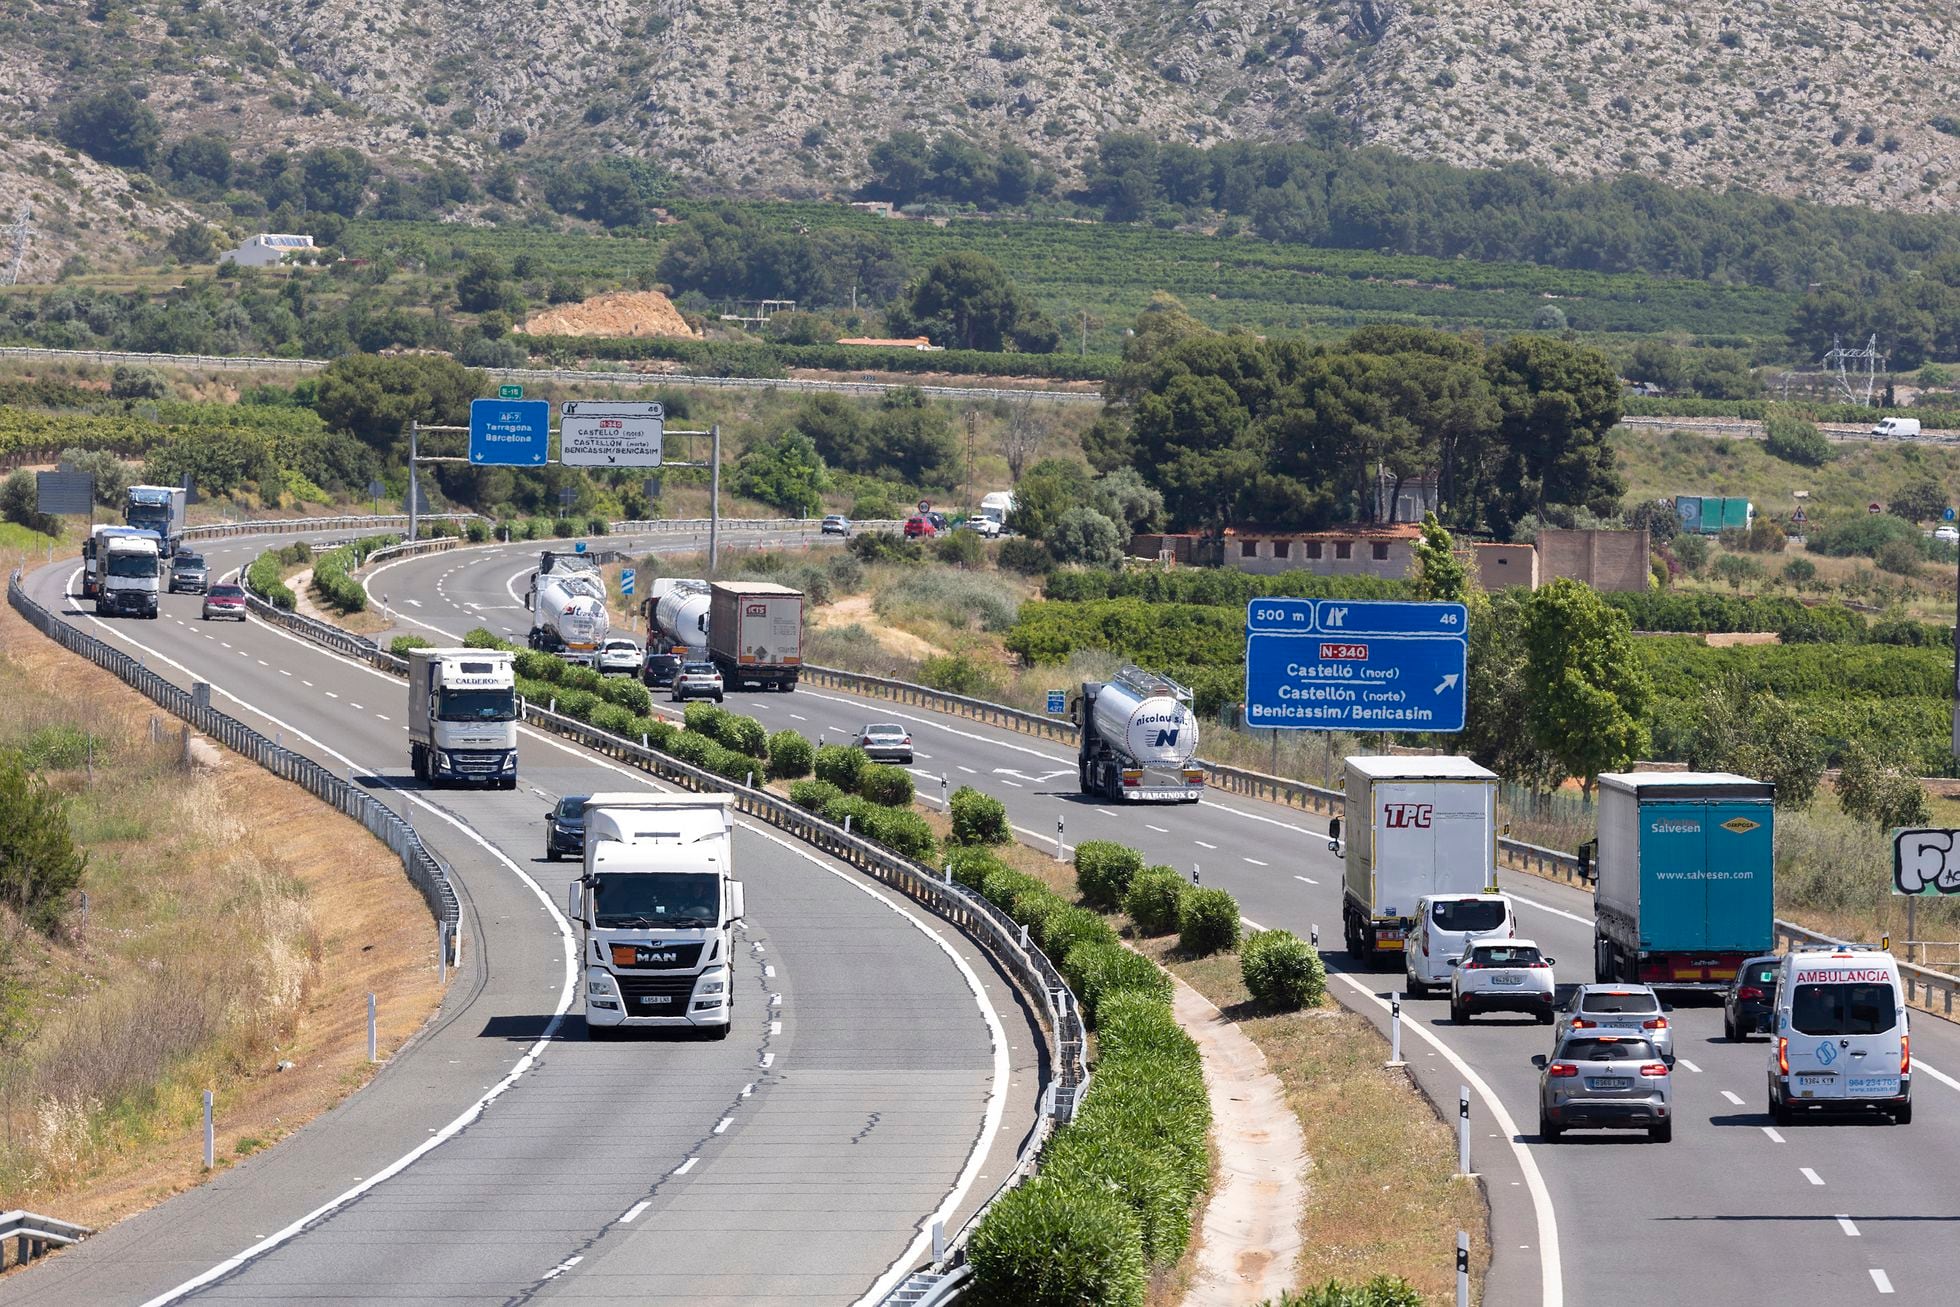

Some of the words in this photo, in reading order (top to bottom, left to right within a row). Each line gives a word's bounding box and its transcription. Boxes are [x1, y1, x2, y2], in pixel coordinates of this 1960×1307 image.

[486, 423, 532, 433] Tarragona
[485, 433, 532, 442] Barcelona
[1256, 609, 1285, 621] 500
[1292, 612, 1305, 621] m
[1439, 613, 1458, 625] 46
[1322, 646, 1366, 658] N-340
[1286, 663, 1353, 678] Castelló
[1360, 667, 1400, 679] (nord)
[1278, 685, 1356, 701] Castellón
[1363, 690, 1407, 702] (norte)
[1136, 713, 1172, 726] nicolau
[1384, 803, 1433, 828] TPC
[1651, 823, 1701, 833] Salvesen
[1656, 870, 1754, 880] www.salvesen.com
[636, 952, 677, 962] MAN
[1796, 970, 1891, 983] AMBULANCIA
